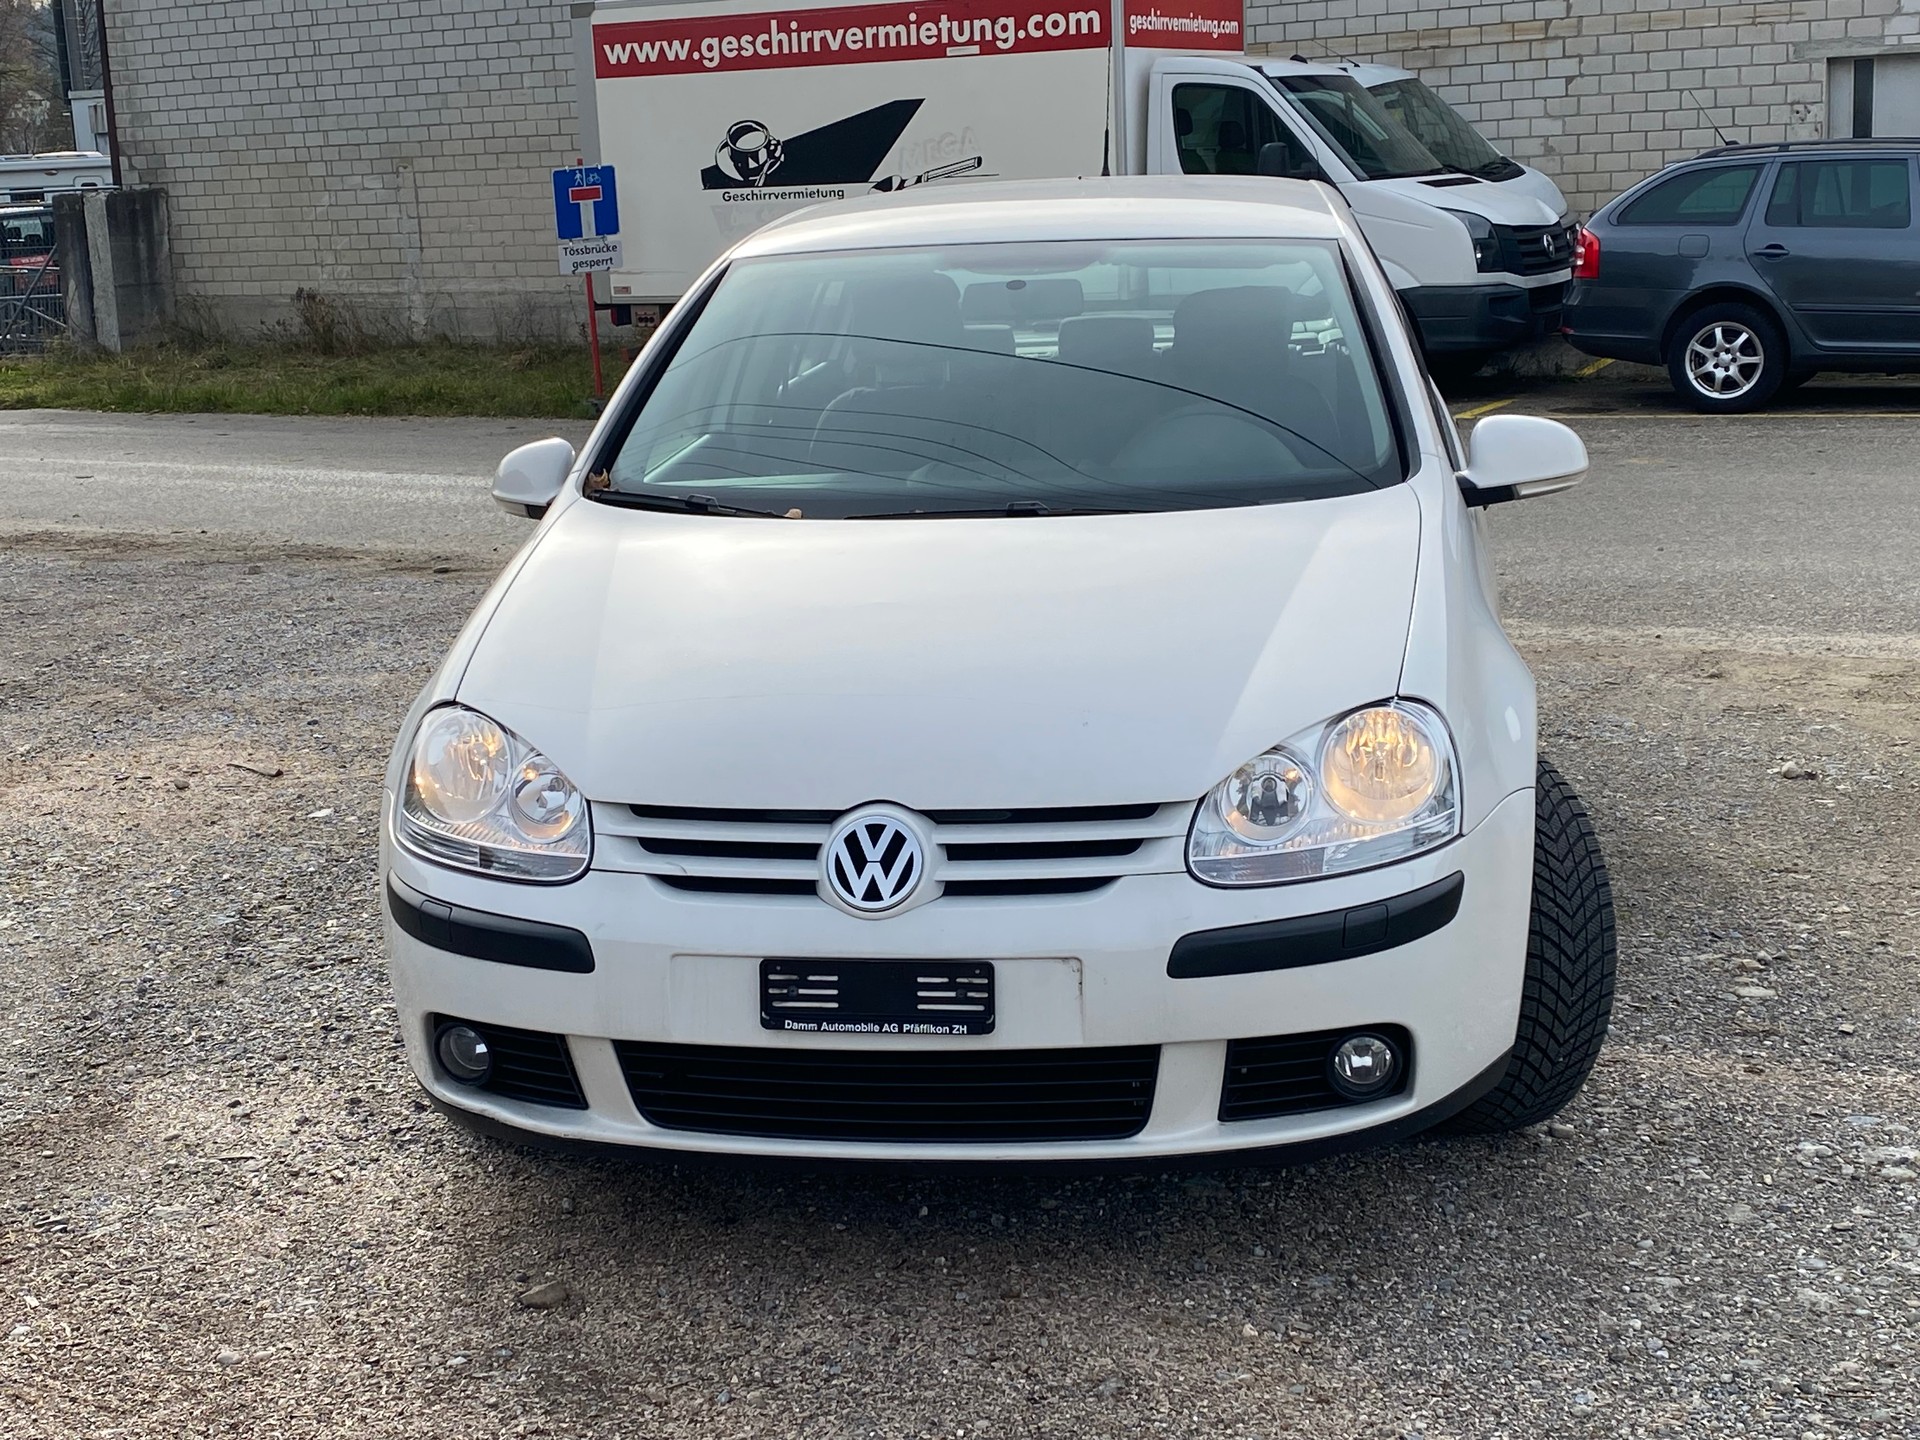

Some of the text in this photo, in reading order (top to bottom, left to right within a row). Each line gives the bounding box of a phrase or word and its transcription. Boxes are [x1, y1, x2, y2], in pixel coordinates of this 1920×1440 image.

[1130, 8, 1239, 38] geschirrvermietung.com
[603, 9, 1101, 68] www.geschirrvermietung.com
[722, 188, 845, 202] Geschirrvermietung
[563, 244, 618, 256] Tössbrücke
[572, 257, 614, 271] gesperrt
[784, 1019, 968, 1034] Damm Automobile AG Pfäffikon ZH
